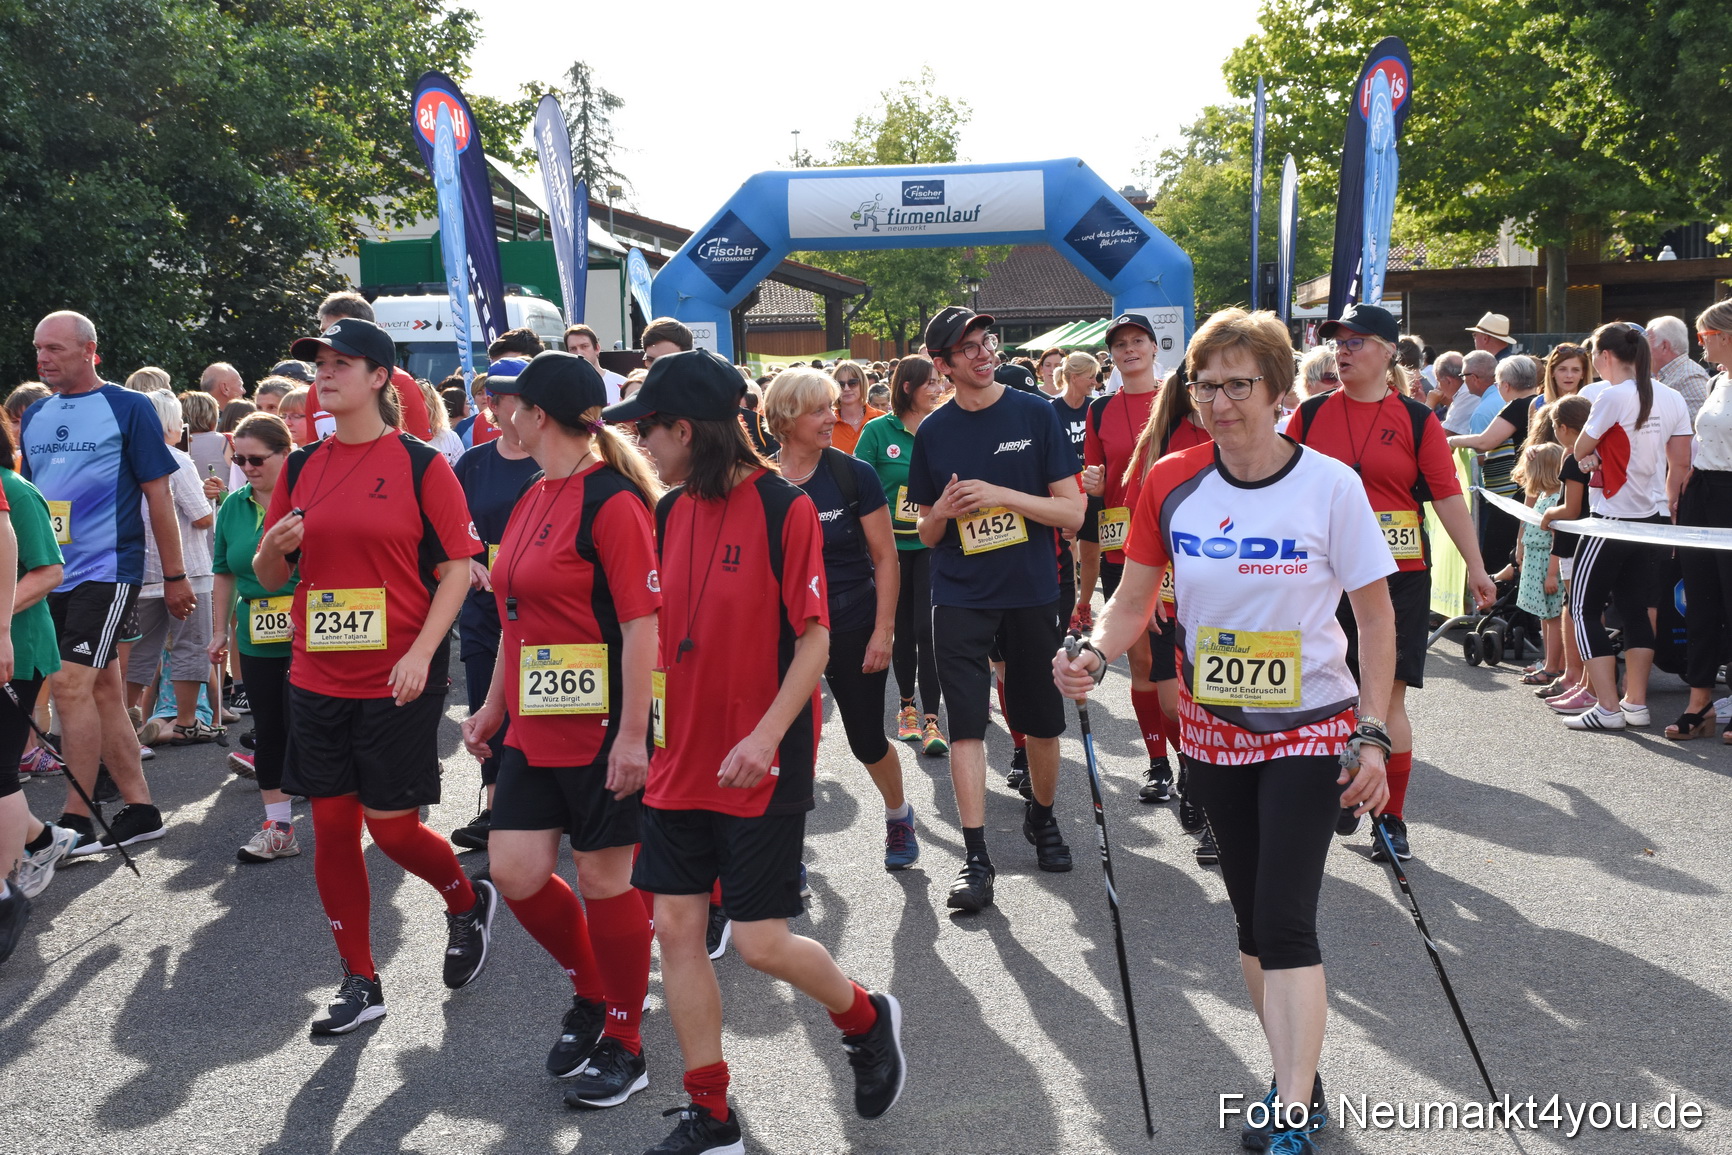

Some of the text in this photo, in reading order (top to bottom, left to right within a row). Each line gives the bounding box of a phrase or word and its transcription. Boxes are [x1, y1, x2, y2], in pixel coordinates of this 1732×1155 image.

[1363, 73, 1404, 108] His
[911, 188, 943, 197] Fischer
[888, 204, 982, 225] firmenlauf
[1096, 230, 1110, 239] das
[707, 245, 758, 257] Fischer
[30, 441, 97, 456] SCHABMÜLLER
[374, 477, 386, 493] 7
[966, 512, 1017, 540] 1452
[1100, 522, 1124, 540] 2337
[1381, 528, 1416, 546] 351
[721, 544, 741, 565] 11
[1238, 558, 1308, 575] energie
[255, 612, 291, 631] 208
[314, 610, 374, 634] 2347
[344, 633, 368, 641] Tatjana
[73, 647, 92, 656] adidas
[1205, 655, 1287, 687] 2070
[528, 669, 596, 696] 2366
[1206, 684, 1287, 695] Irmgard Endruschat
[541, 695, 581, 704] Würz Birgit
